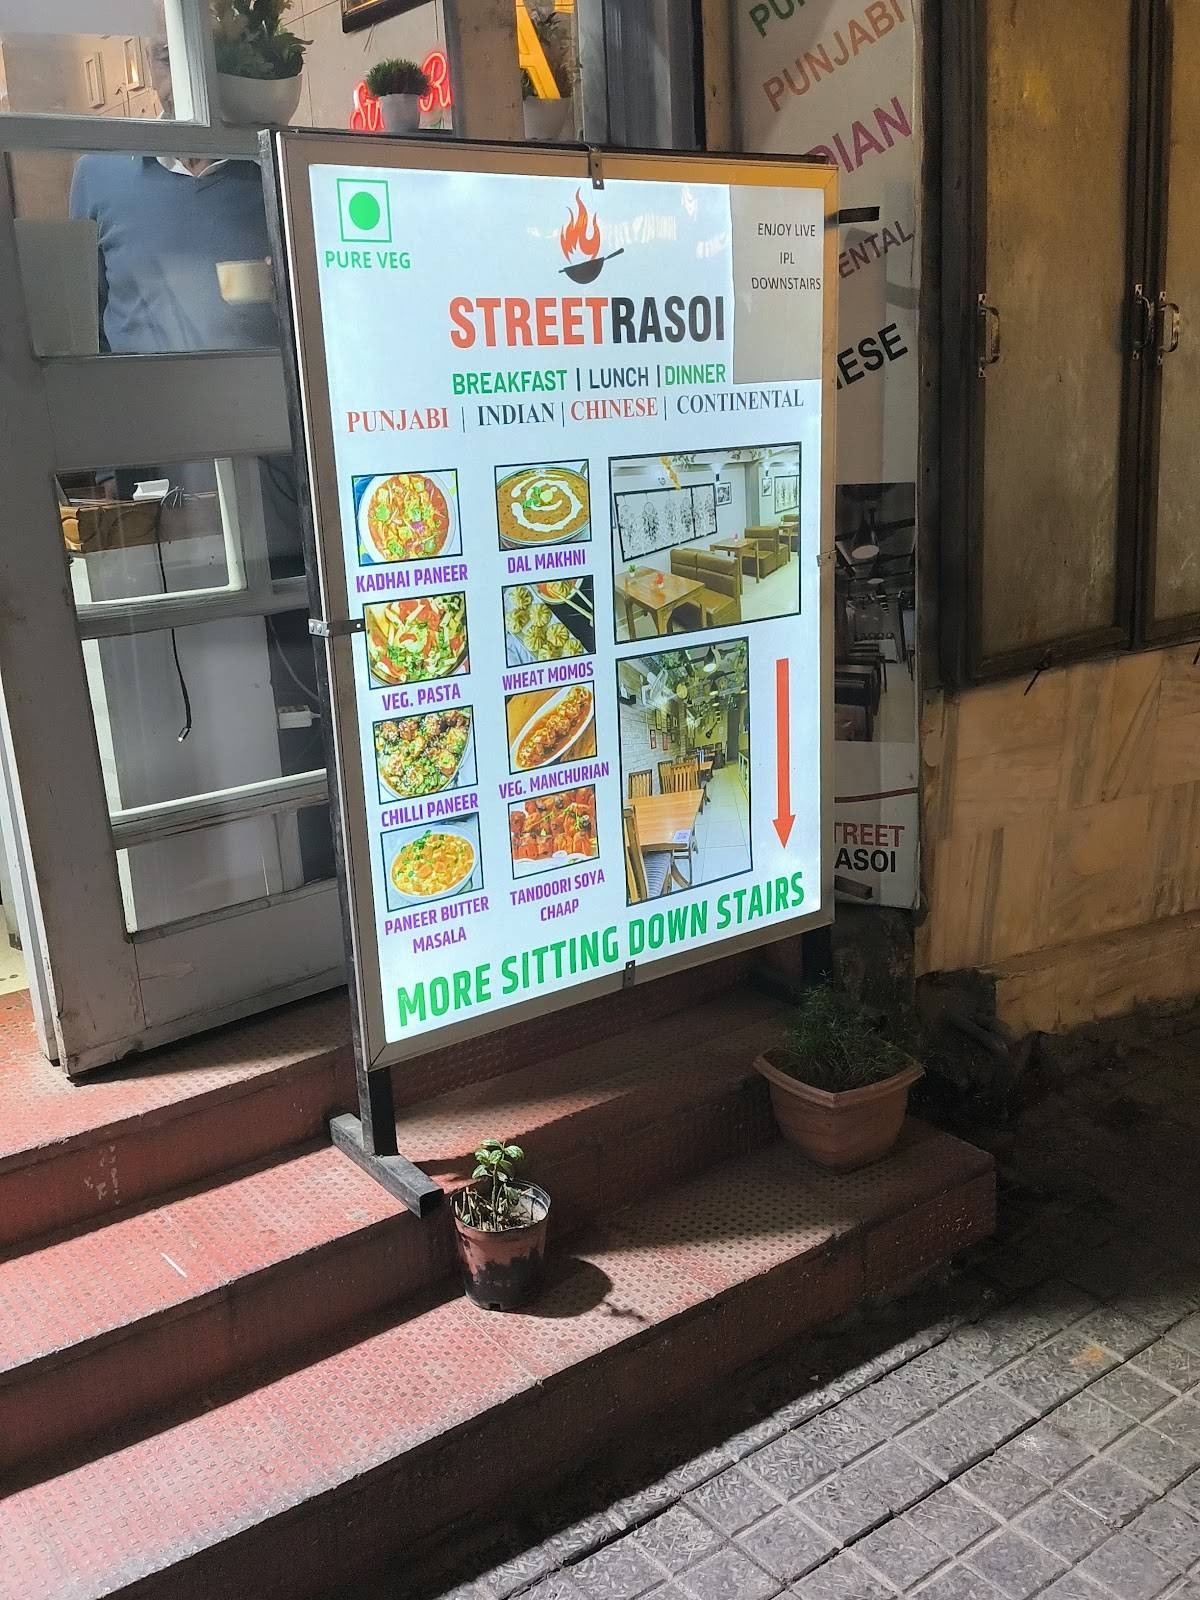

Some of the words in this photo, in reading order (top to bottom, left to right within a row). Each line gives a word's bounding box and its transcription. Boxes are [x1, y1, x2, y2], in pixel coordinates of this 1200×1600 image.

[762, 0, 906, 112] PUNJABI
[757, 222, 792, 237] ENJOY
[795, 224, 816, 237] LIVE
[325, 250, 372, 269] PURE
[376, 251, 411, 269] VEG
[780, 251, 795, 265] IPL
[751, 277, 822, 290] DOWNSTAIRS
[837, 322, 909, 391] ESE
[452, 369, 567, 395] BREAKFAST
[589, 367, 649, 389] LUNCH
[665, 363, 726, 386] DINNER
[346, 407, 449, 433] PUNJABI
[478, 402, 554, 426] INDIAN
[570, 397, 659, 421] CHINESE
[676, 388, 804, 415] CONTINENTAL
[507, 555, 532, 574] DAL
[535, 548, 586, 570] MAKHNI
[355, 569, 411, 593] KADHAI
[414, 563, 468, 585] PANEER
[502, 669, 545, 691] WHEAT
[547, 661, 594, 683] MOMOS
[382, 691, 414, 711] VEG.
[417, 682, 461, 704] PASTA
[499, 778, 527, 800] VEG.
[530, 761, 610, 791] MANCHURIAN
[381, 801, 424, 828] CHILLI
[427, 792, 479, 818] PANEER
[509, 879, 572, 906] TANDOORI
[574, 868, 606, 893] SOYA
[384, 911, 438, 936] PANEER
[440, 896, 489, 922] BUTTER
[540, 898, 580, 922] CHAAP
[397, 963, 492, 1028] MORE
[501, 925, 620, 995] SITTING
[628, 899, 709, 957] DOWN
[716, 871, 806, 931] STAIRS
[412, 926, 467, 954] MASALA
